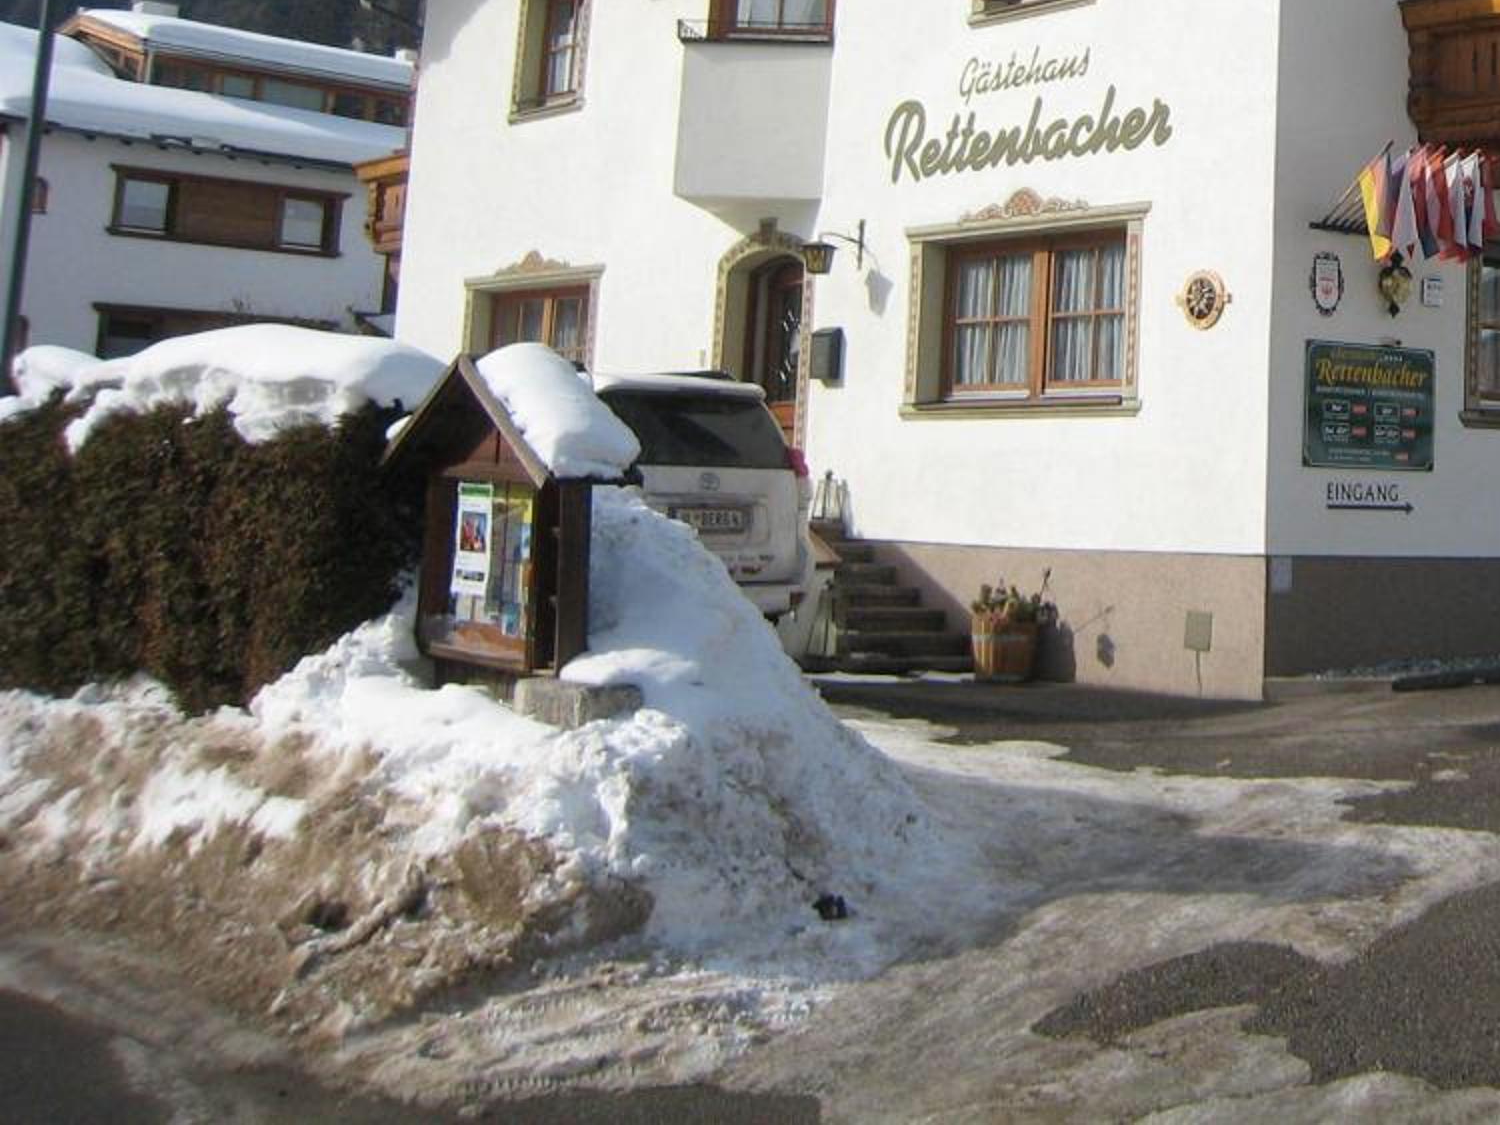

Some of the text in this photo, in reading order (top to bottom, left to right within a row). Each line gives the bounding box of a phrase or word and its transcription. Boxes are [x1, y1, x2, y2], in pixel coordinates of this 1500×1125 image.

[959, 46, 1091, 104] Gästehaus
[884, 84, 1173, 185] Rettenbacher
[1326, 482, 1399, 502] EINGANG
